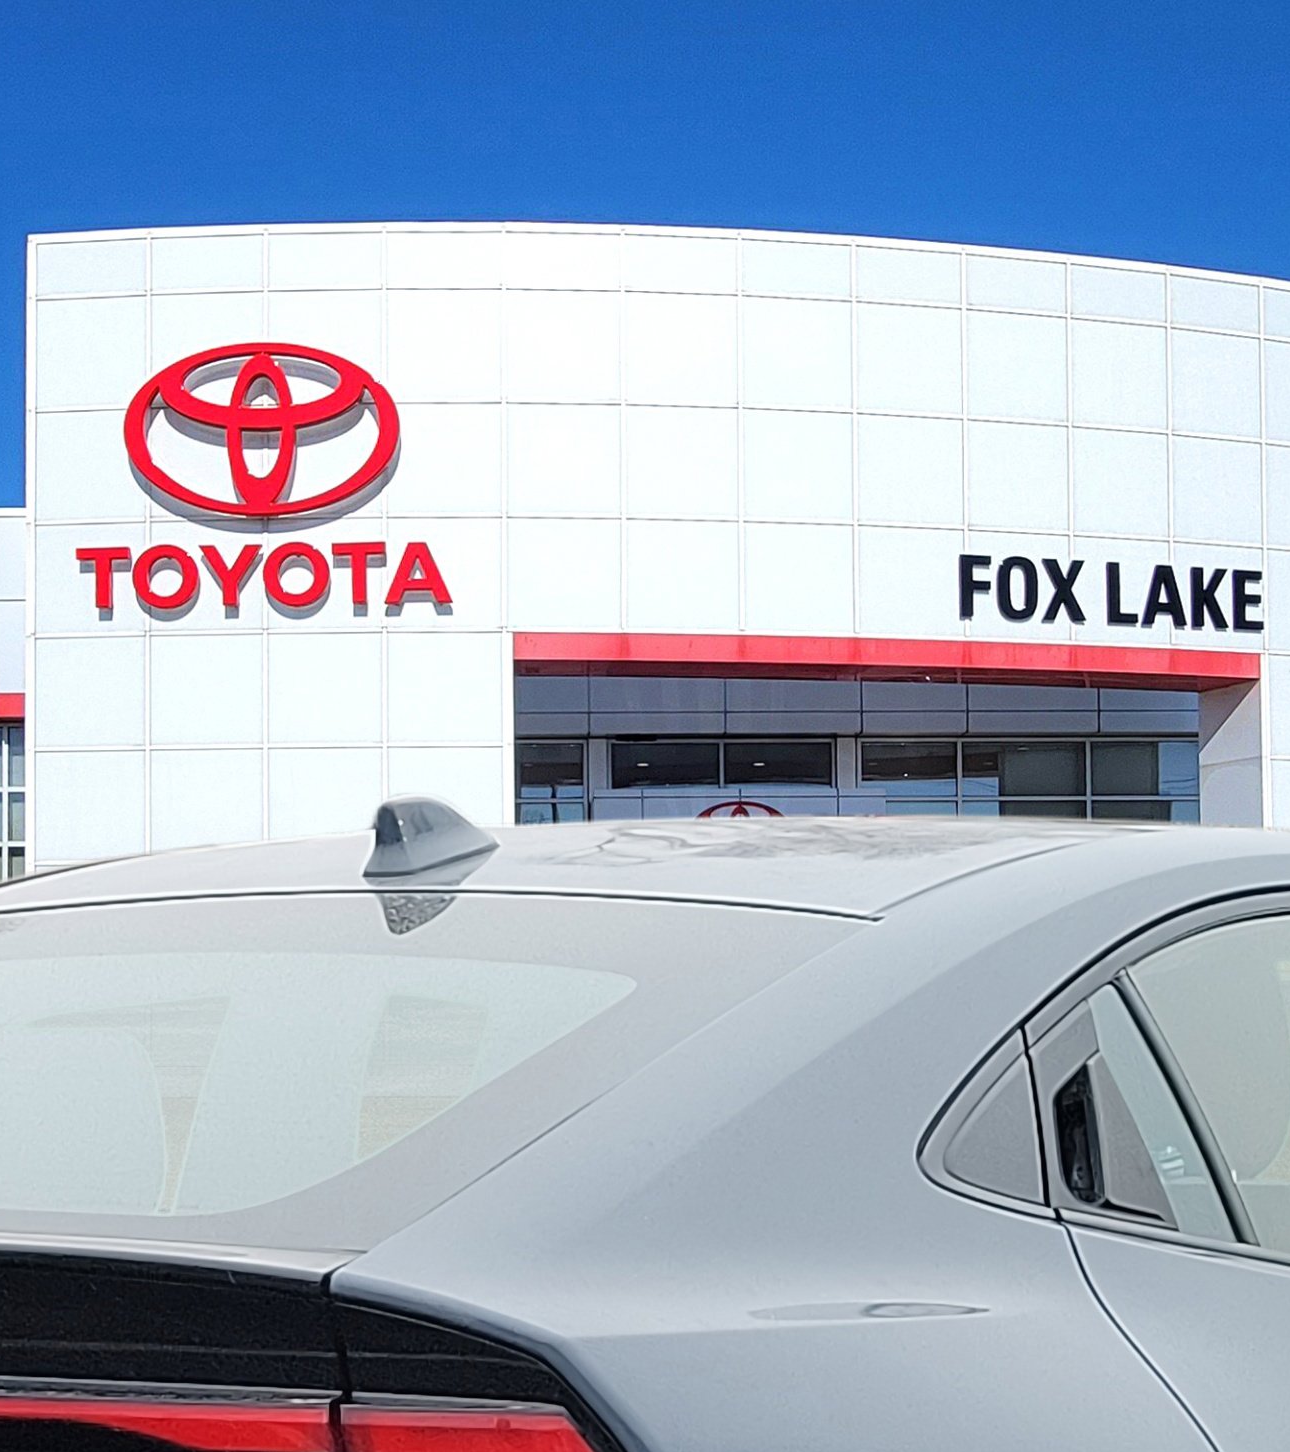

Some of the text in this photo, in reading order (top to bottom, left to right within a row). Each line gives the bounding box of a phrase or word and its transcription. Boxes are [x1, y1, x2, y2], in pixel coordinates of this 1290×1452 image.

[75, 541, 454, 610] TOYOTA
[959, 554, 1264, 631] FOX LAKE
